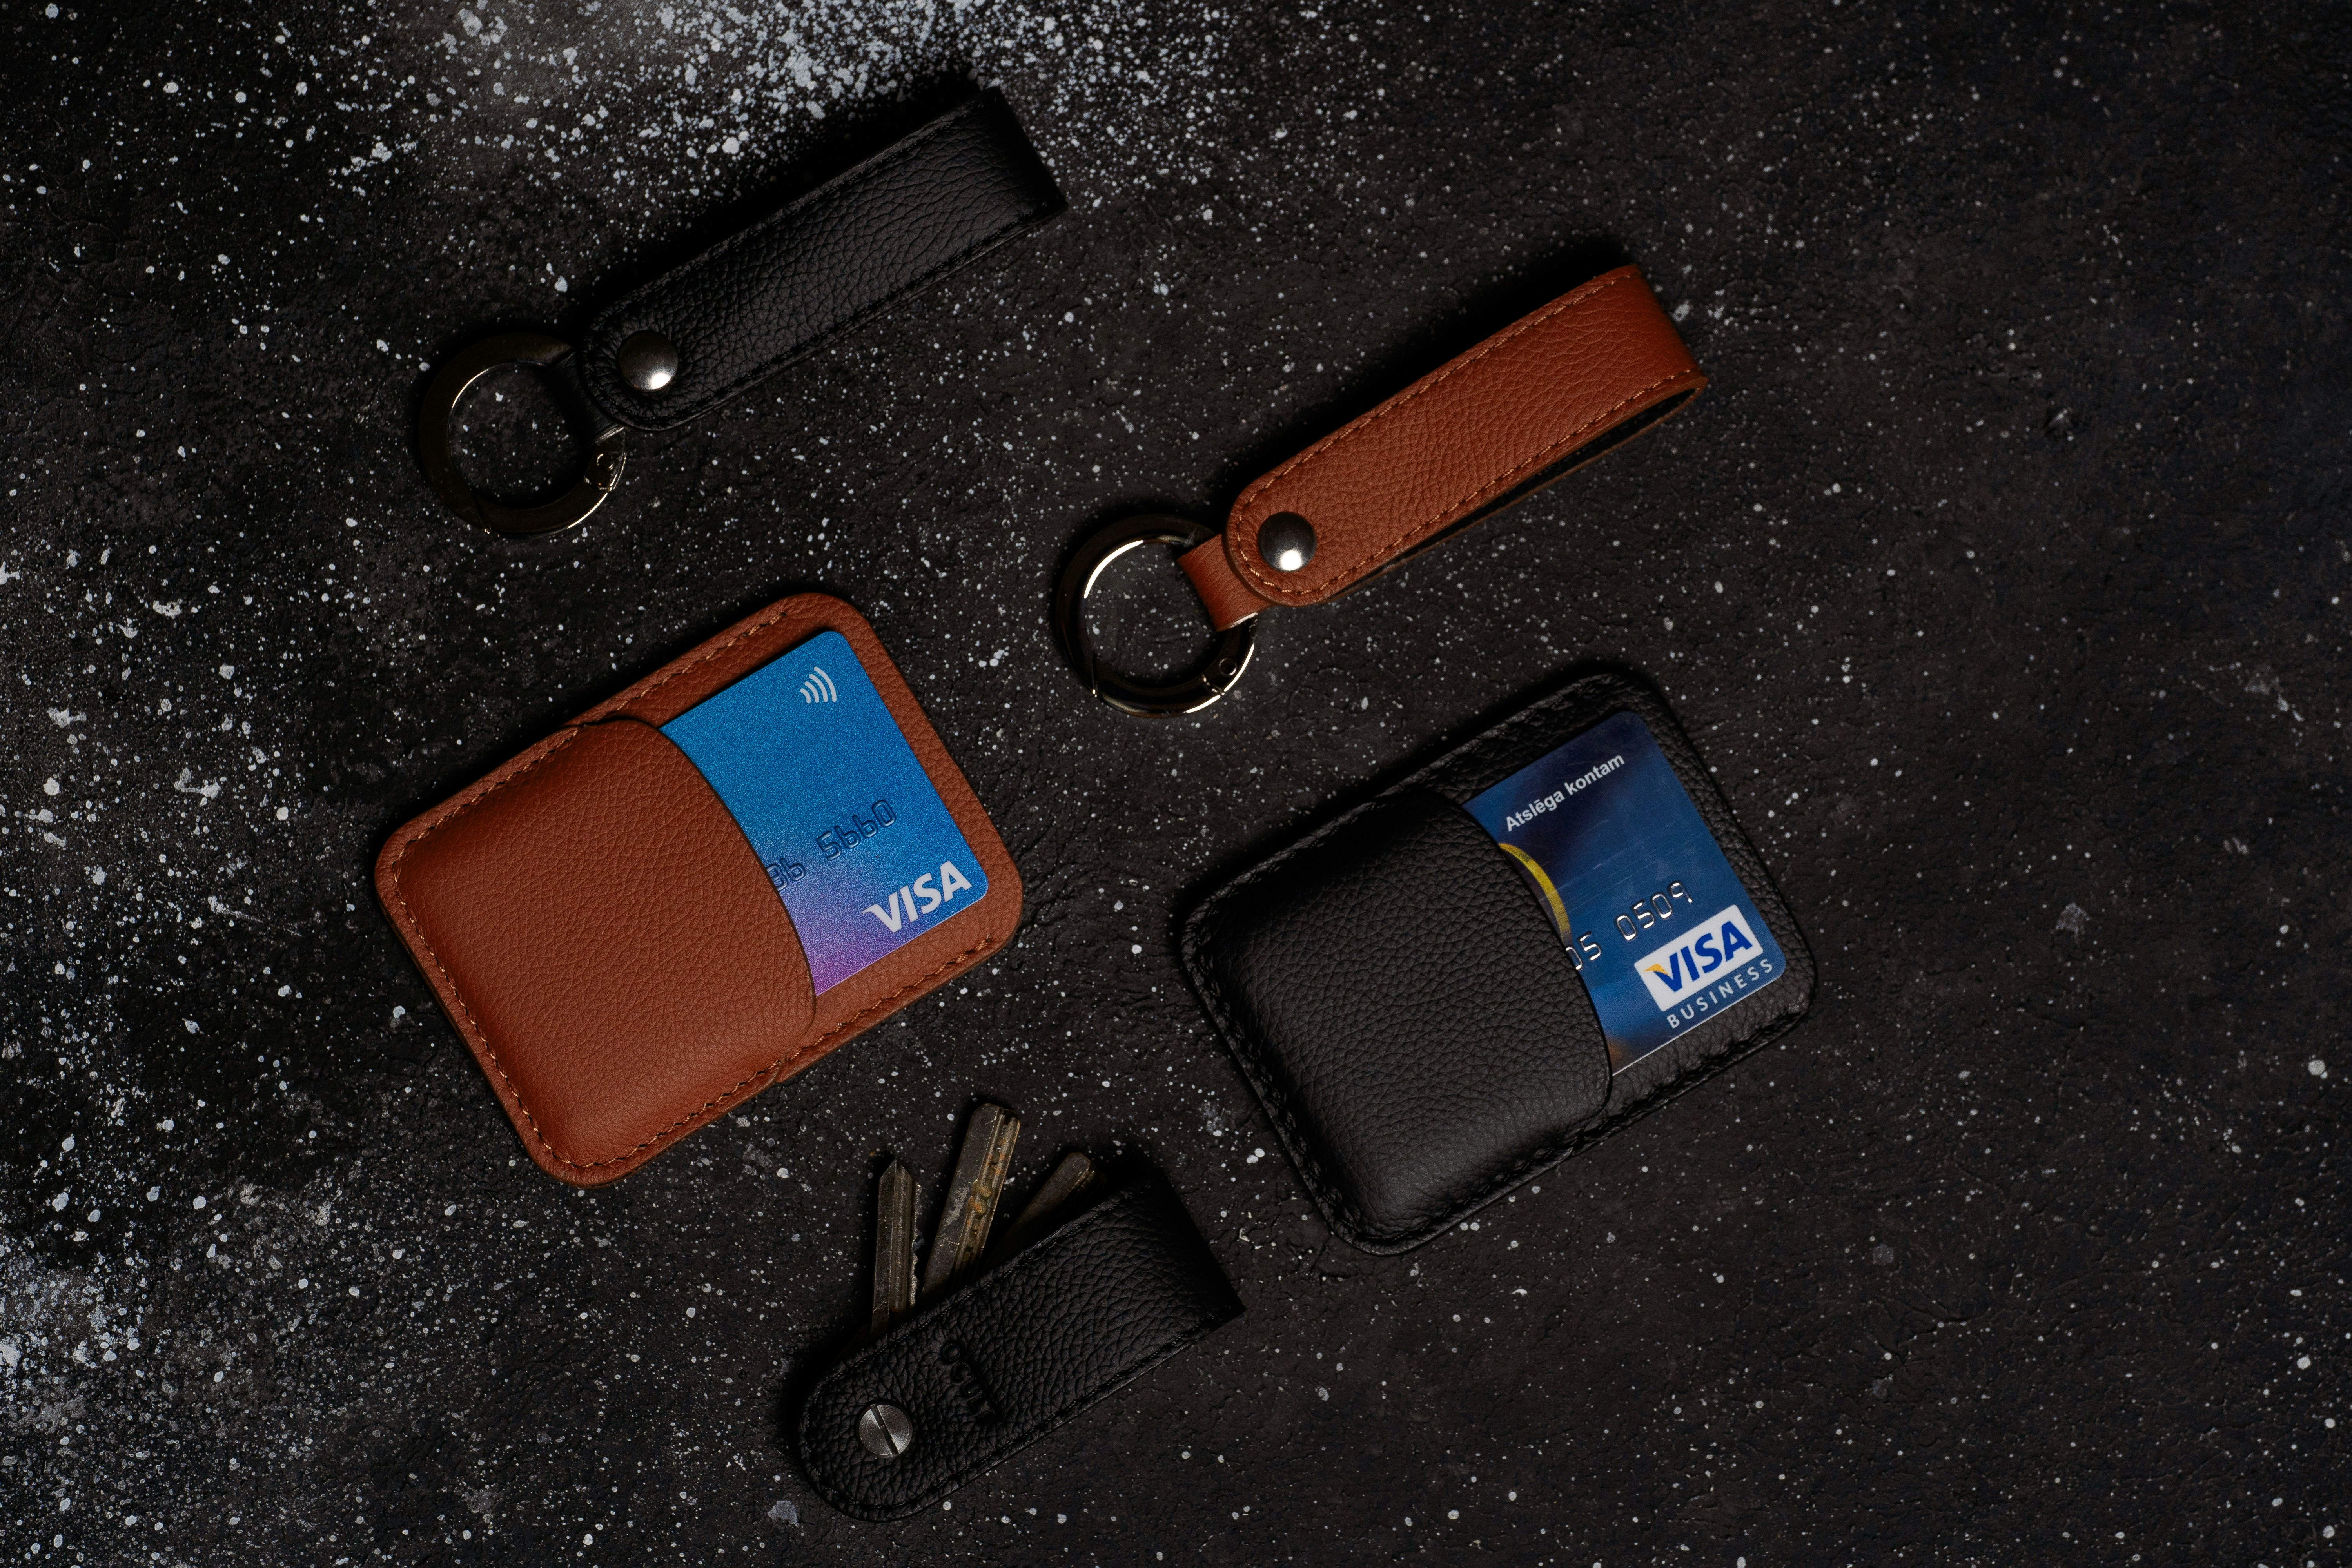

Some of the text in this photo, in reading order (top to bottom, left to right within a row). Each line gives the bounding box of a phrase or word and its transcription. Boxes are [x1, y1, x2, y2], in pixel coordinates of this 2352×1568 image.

[1506, 755, 1625, 831] Atslēga kontam
[816, 800, 897, 861] 5660
[862, 860, 972, 933] VISA
[1615, 881, 1692, 940] 0509
[1643, 921, 1753, 992] VISA
[1666, 958, 1773, 1029] BUSINESS
